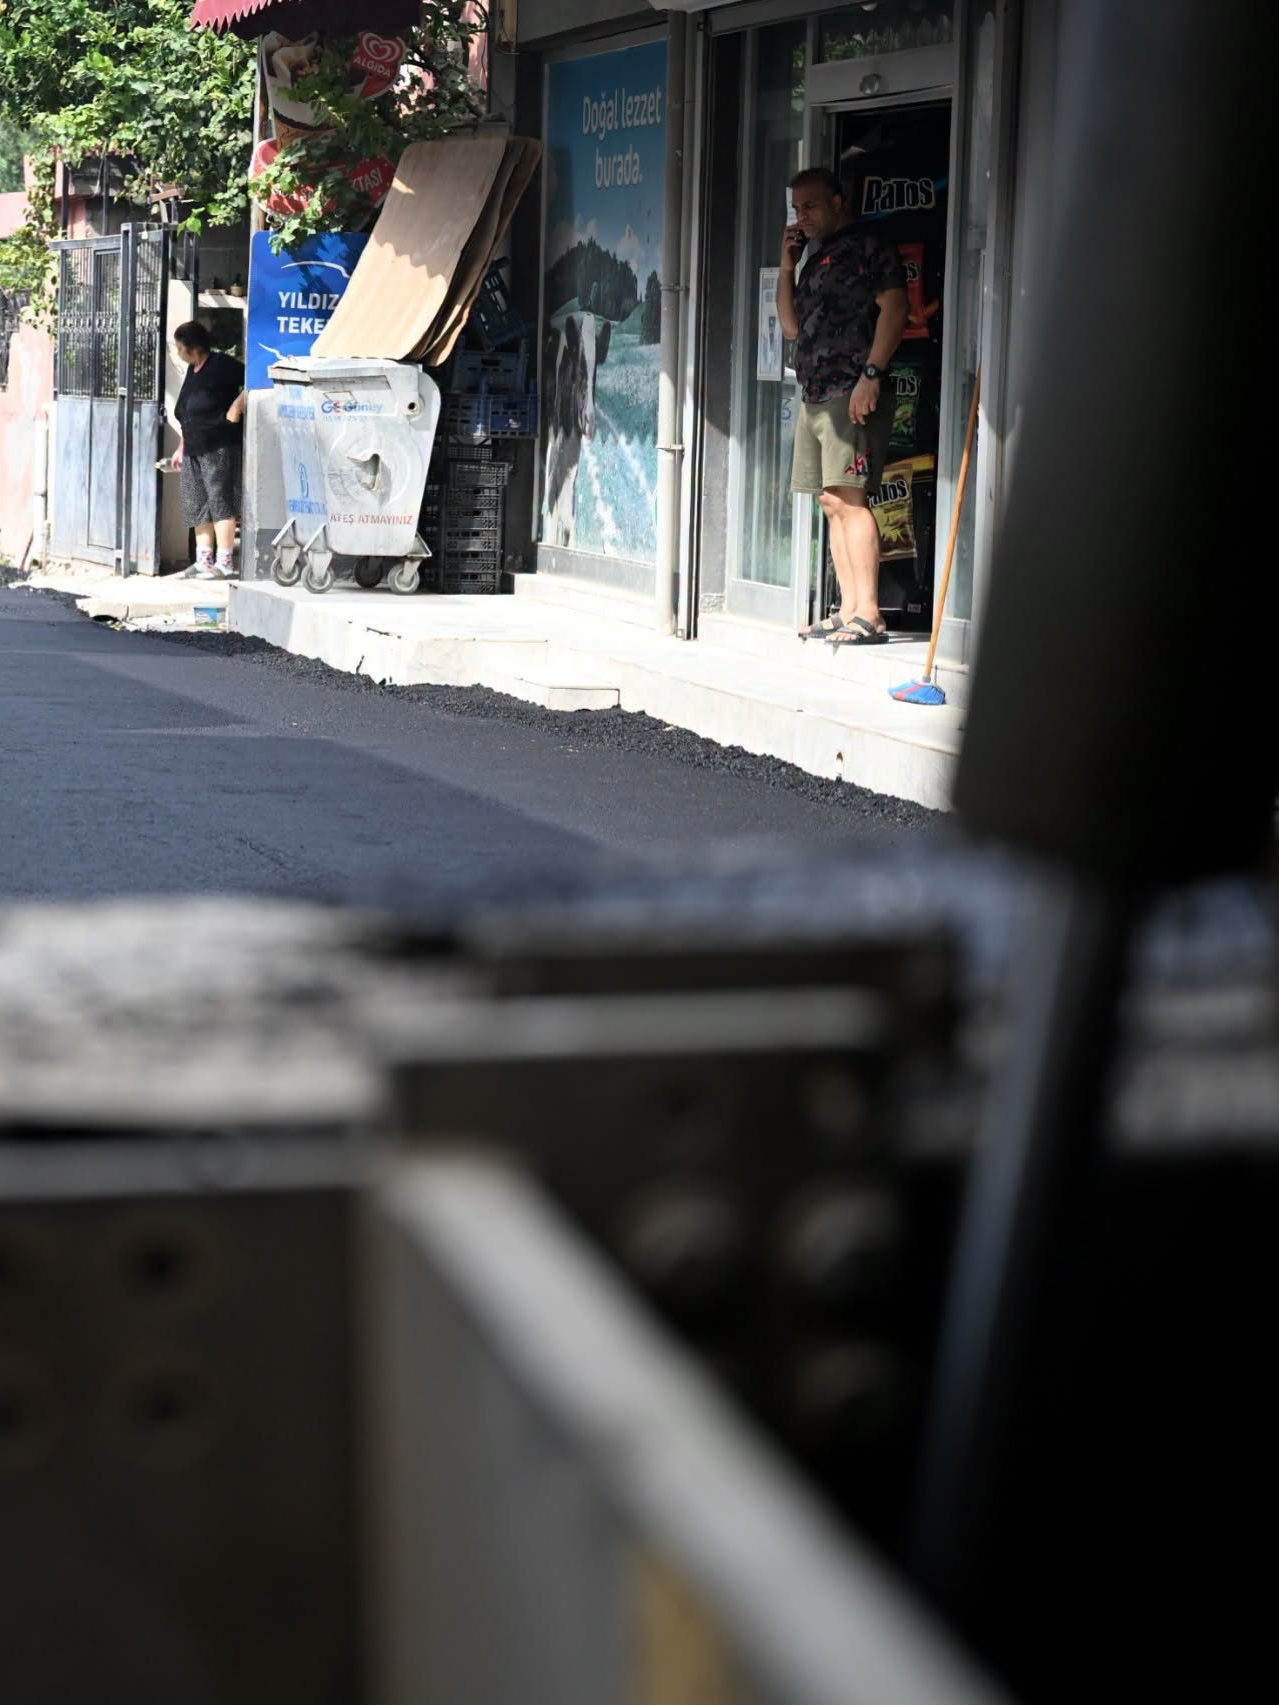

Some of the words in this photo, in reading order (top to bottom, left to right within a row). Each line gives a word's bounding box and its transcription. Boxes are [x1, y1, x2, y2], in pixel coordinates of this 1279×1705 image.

[353, 56, 391, 78] ALGIDA
[582, 88, 619, 141] Doğal
[622, 85, 662, 129] lezzet
[595, 144, 644, 189] burada.
[278, 291, 339, 310] YILDIZ
[277, 316, 325, 335] TEKE
[358, 514, 414, 526] ATMAYINIZ
